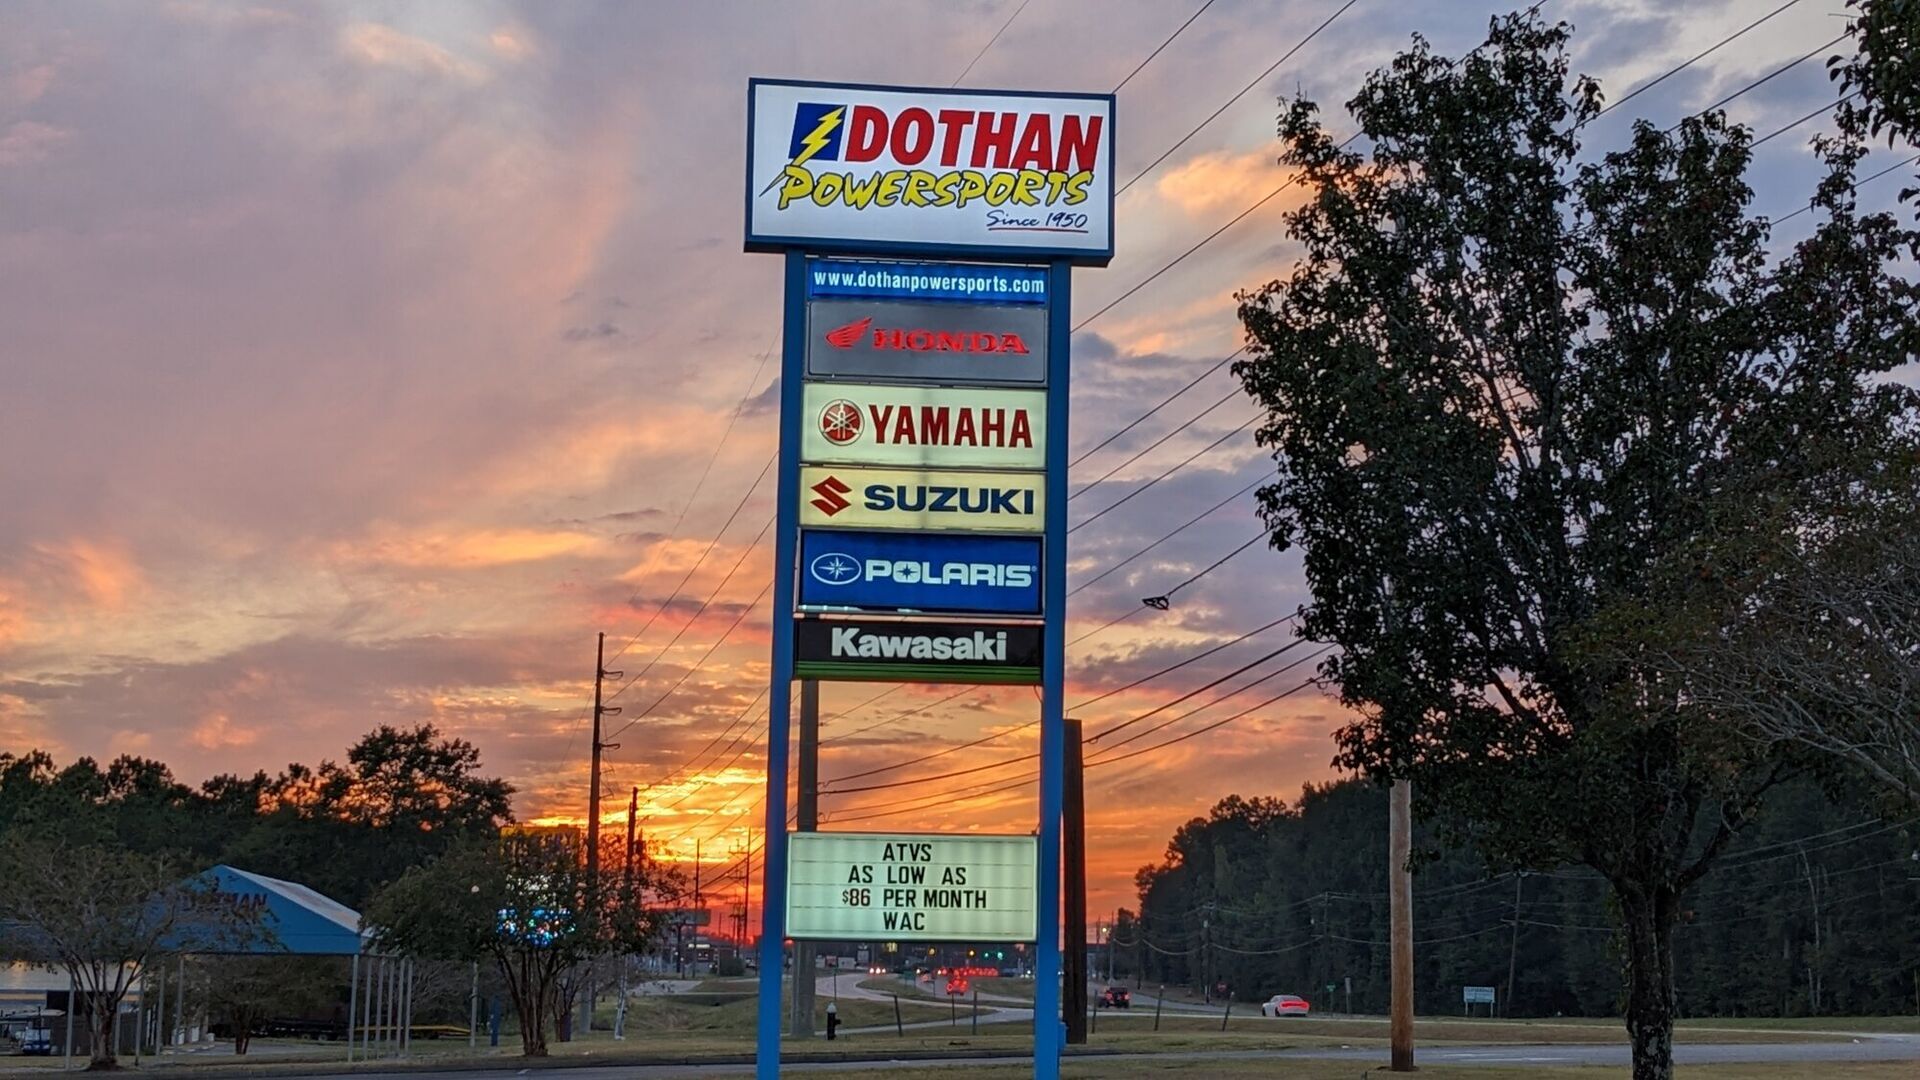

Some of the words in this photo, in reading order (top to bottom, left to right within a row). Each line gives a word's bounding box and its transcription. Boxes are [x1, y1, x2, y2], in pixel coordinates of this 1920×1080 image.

[844, 104, 1104, 172] DOTHAN
[777, 164, 1095, 211] POWERSPORTS
[985, 209, 1041, 228] Since
[1045, 211, 1089, 229] 1950
[813, 270, 1045, 295] www.dothanpowersports.com
[873, 328, 1031, 355] HONDA
[868, 404, 1033, 449] YAMAHA
[863, 484, 1035, 515] SUZUKI
[865, 559, 1032, 588] POLARIS
[831, 627, 1007, 661] Kawasaki
[882, 842, 932, 862] ATVS
[847, 865, 874, 884] AS
[887, 865, 926, 884] LOW
[941, 867, 966, 885] AS
[842, 888, 871, 907] $86
[883, 889, 916, 907] PER
[924, 889, 987, 909] MONTH
[883, 911, 925, 931] WAC
